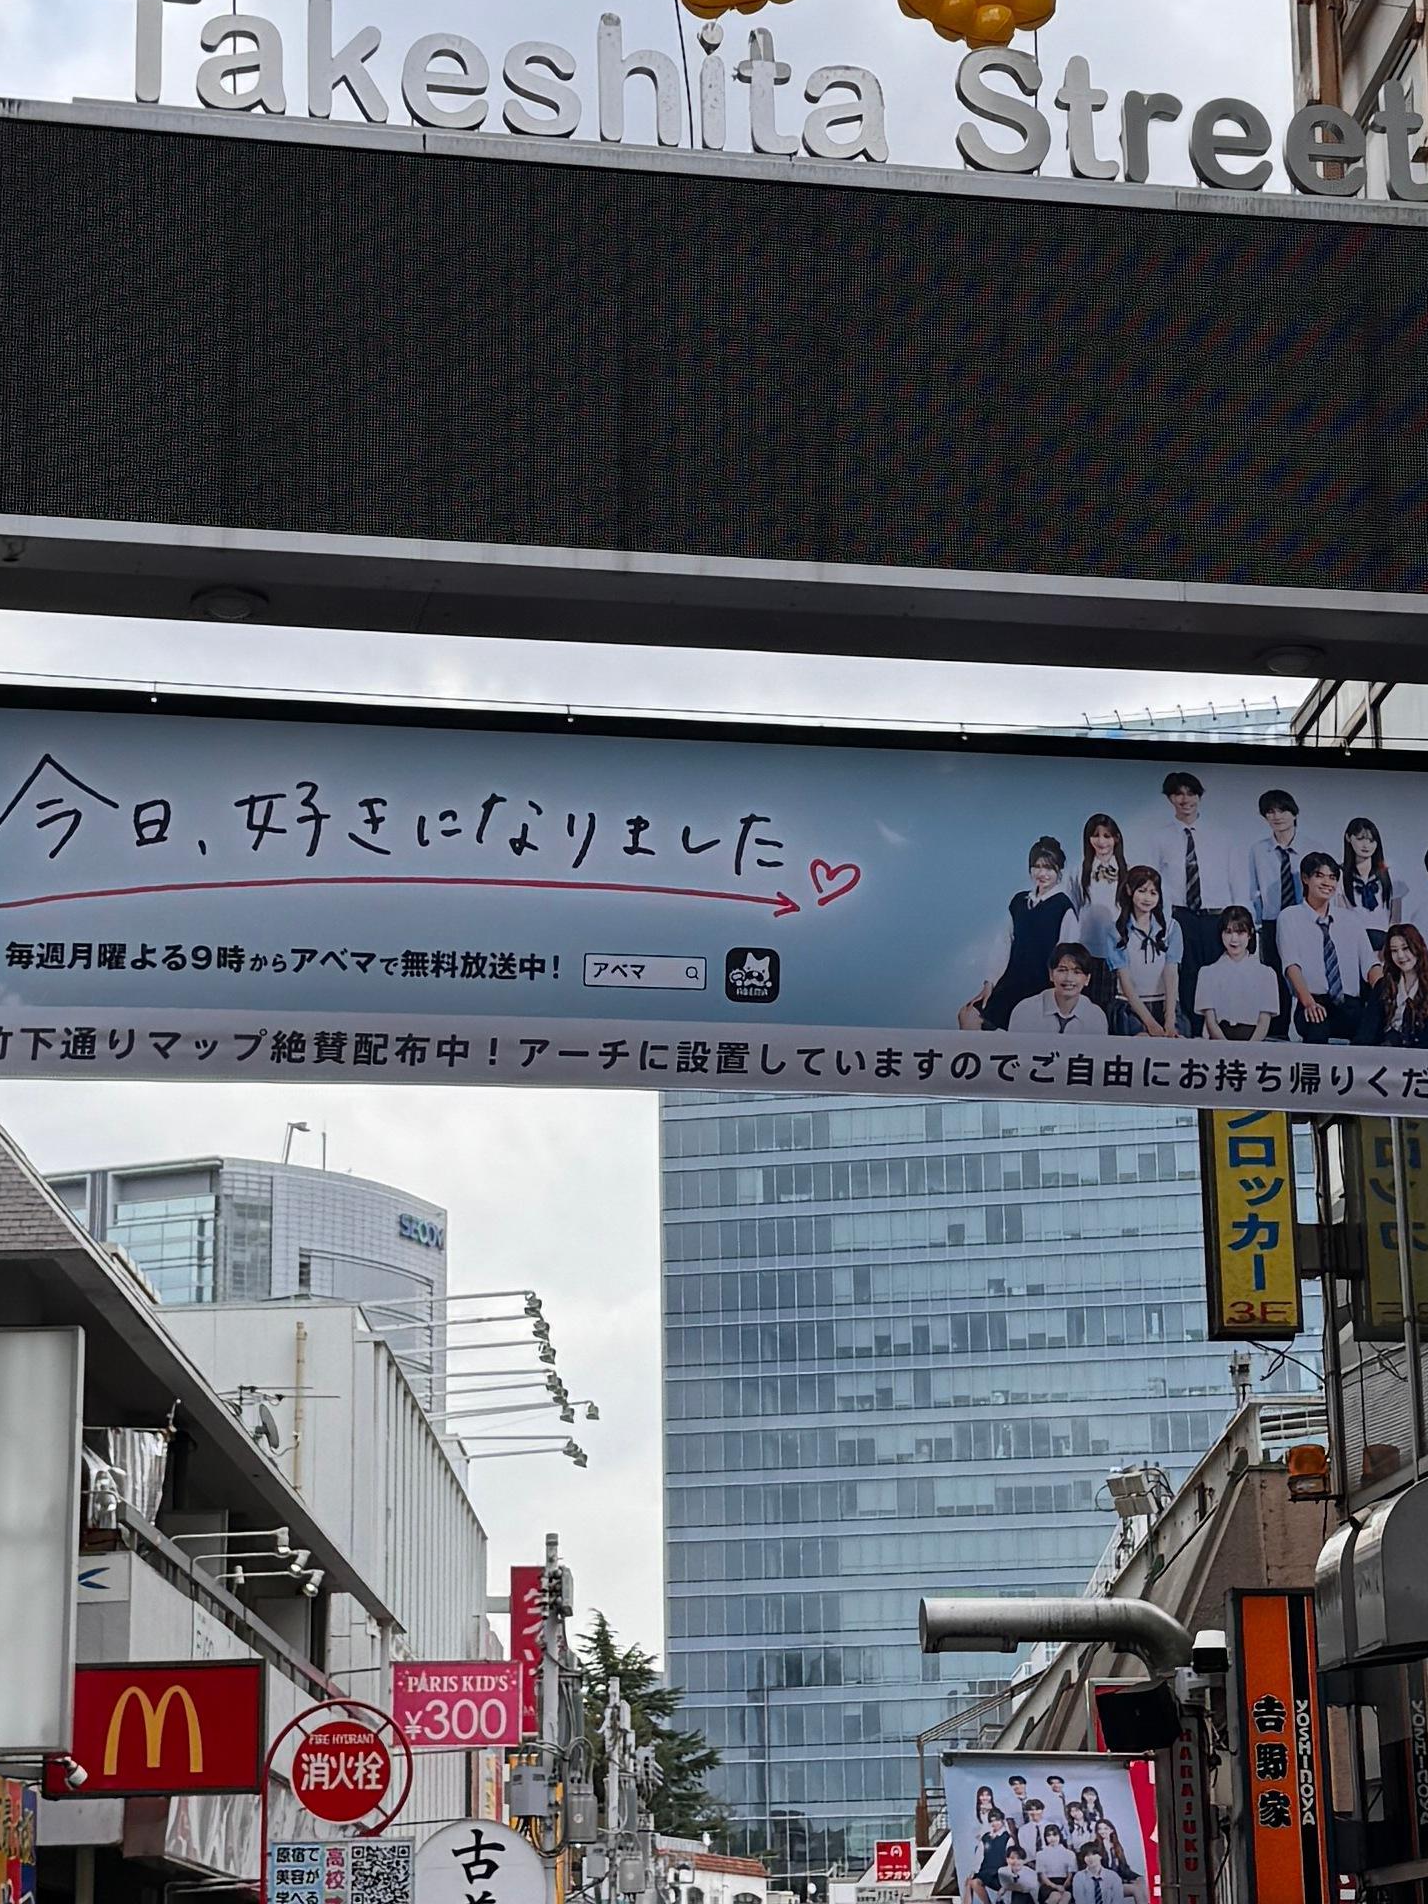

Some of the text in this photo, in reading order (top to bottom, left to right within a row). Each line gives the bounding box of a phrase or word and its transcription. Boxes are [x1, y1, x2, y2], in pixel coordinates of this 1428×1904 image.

[592, 961, 646, 981] アベマ
[406, 1672, 510, 1693] PARIS KID'S
[404, 1697, 507, 1741] ¥300
[300, 1750, 385, 1792] 消火栓
[1252, 1693, 1292, 1830] 吉野家
[1294, 1698, 1316, 1827] YOSHINOYA
